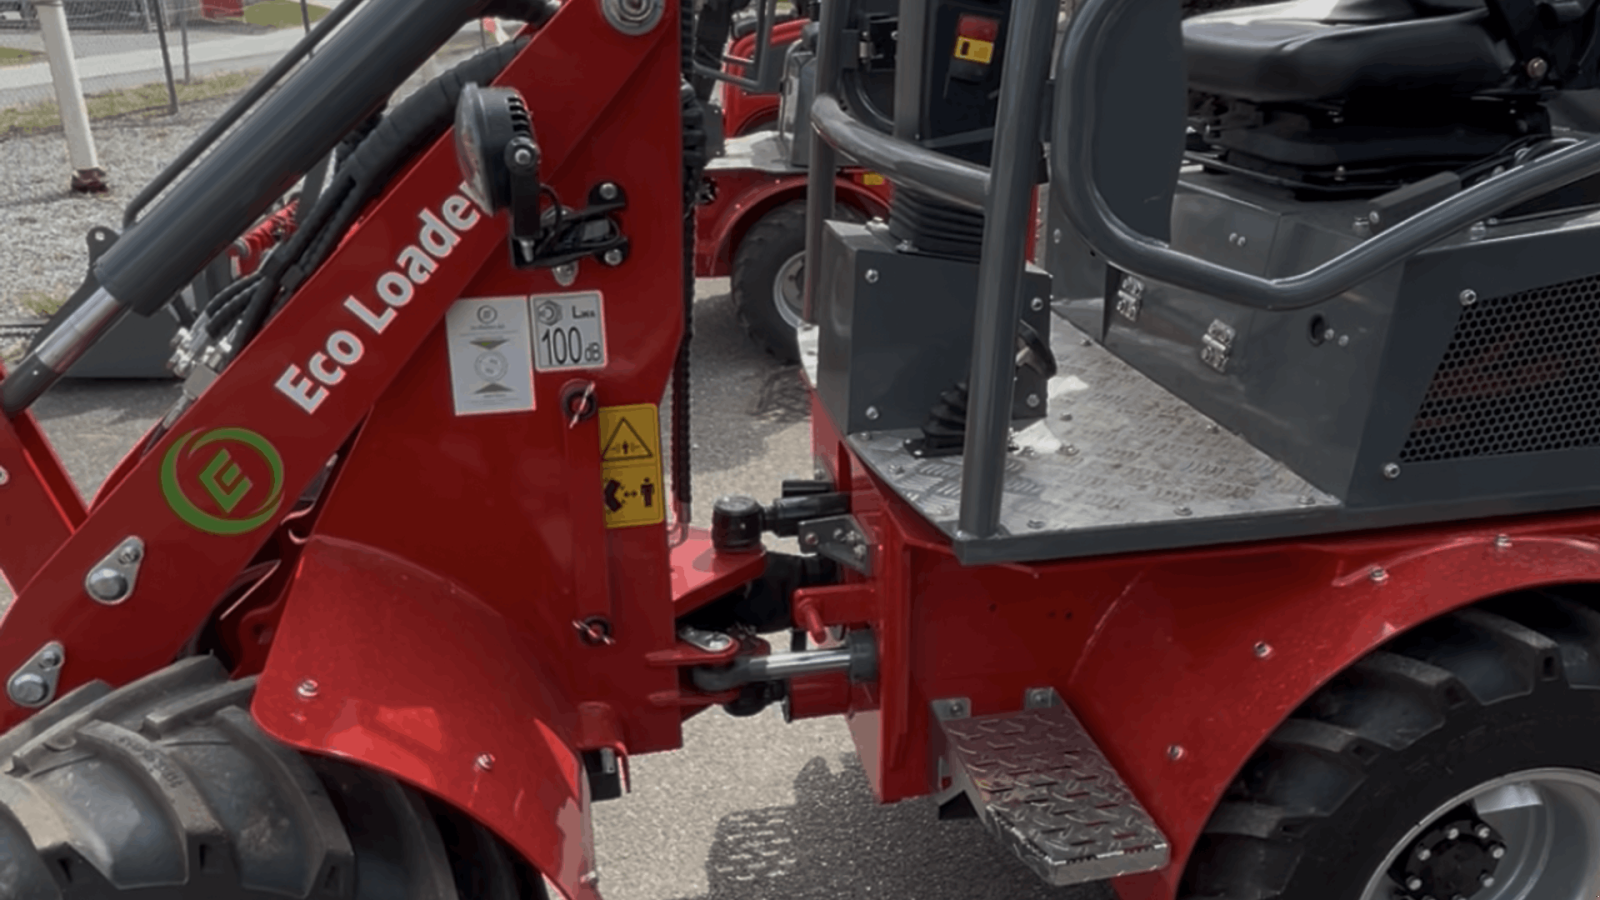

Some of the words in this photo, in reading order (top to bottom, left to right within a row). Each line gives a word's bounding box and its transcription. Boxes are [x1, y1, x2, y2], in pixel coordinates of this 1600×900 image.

[274, 330, 365, 415] Eco
[541, 326, 583, 365] 100
[584, 341, 601, 361] dB
